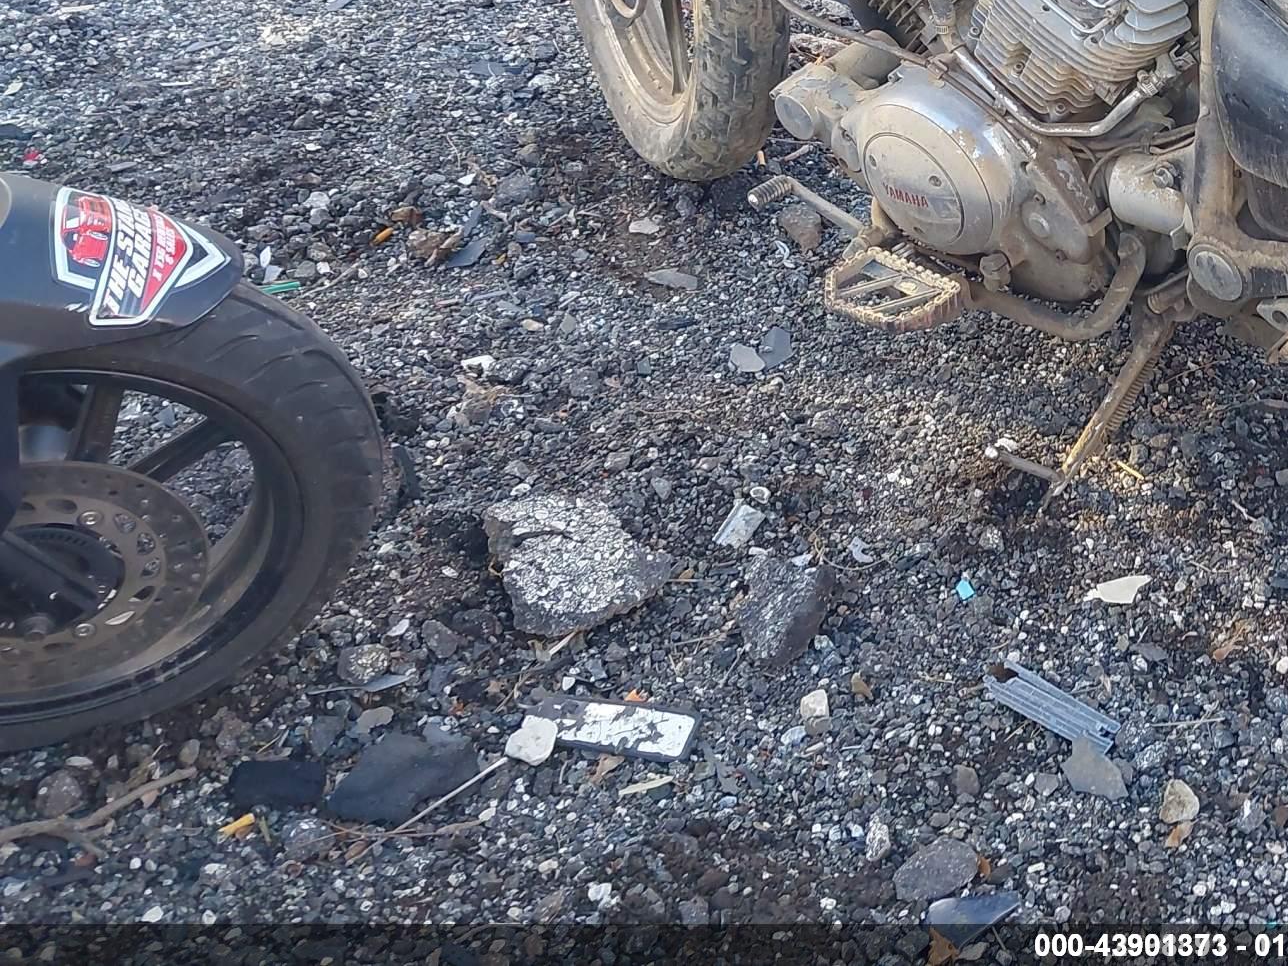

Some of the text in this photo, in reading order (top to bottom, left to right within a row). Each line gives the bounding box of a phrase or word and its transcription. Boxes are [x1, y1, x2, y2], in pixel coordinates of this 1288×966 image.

[883, 183, 929, 208] YAMAHA
[127, 206, 152, 299] GARAG
[104, 254, 129, 315] THE
